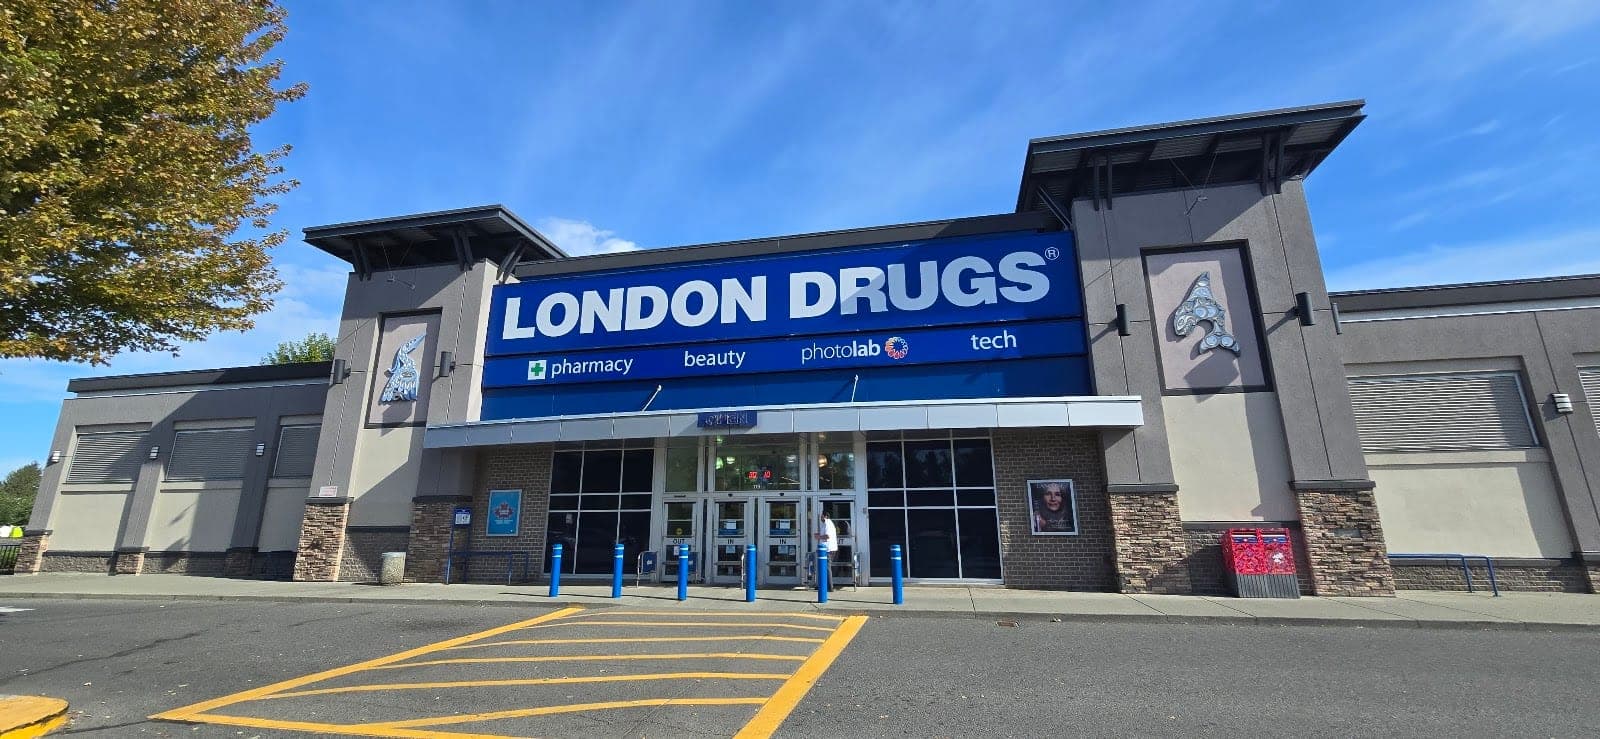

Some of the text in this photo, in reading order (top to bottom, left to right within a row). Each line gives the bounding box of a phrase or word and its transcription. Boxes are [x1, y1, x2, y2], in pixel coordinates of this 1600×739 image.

[503, 275, 766, 340] LONDON
[789, 251, 1050, 319] DRUGS
[551, 329, 1017, 379] pharmacy beauty photolab tech
